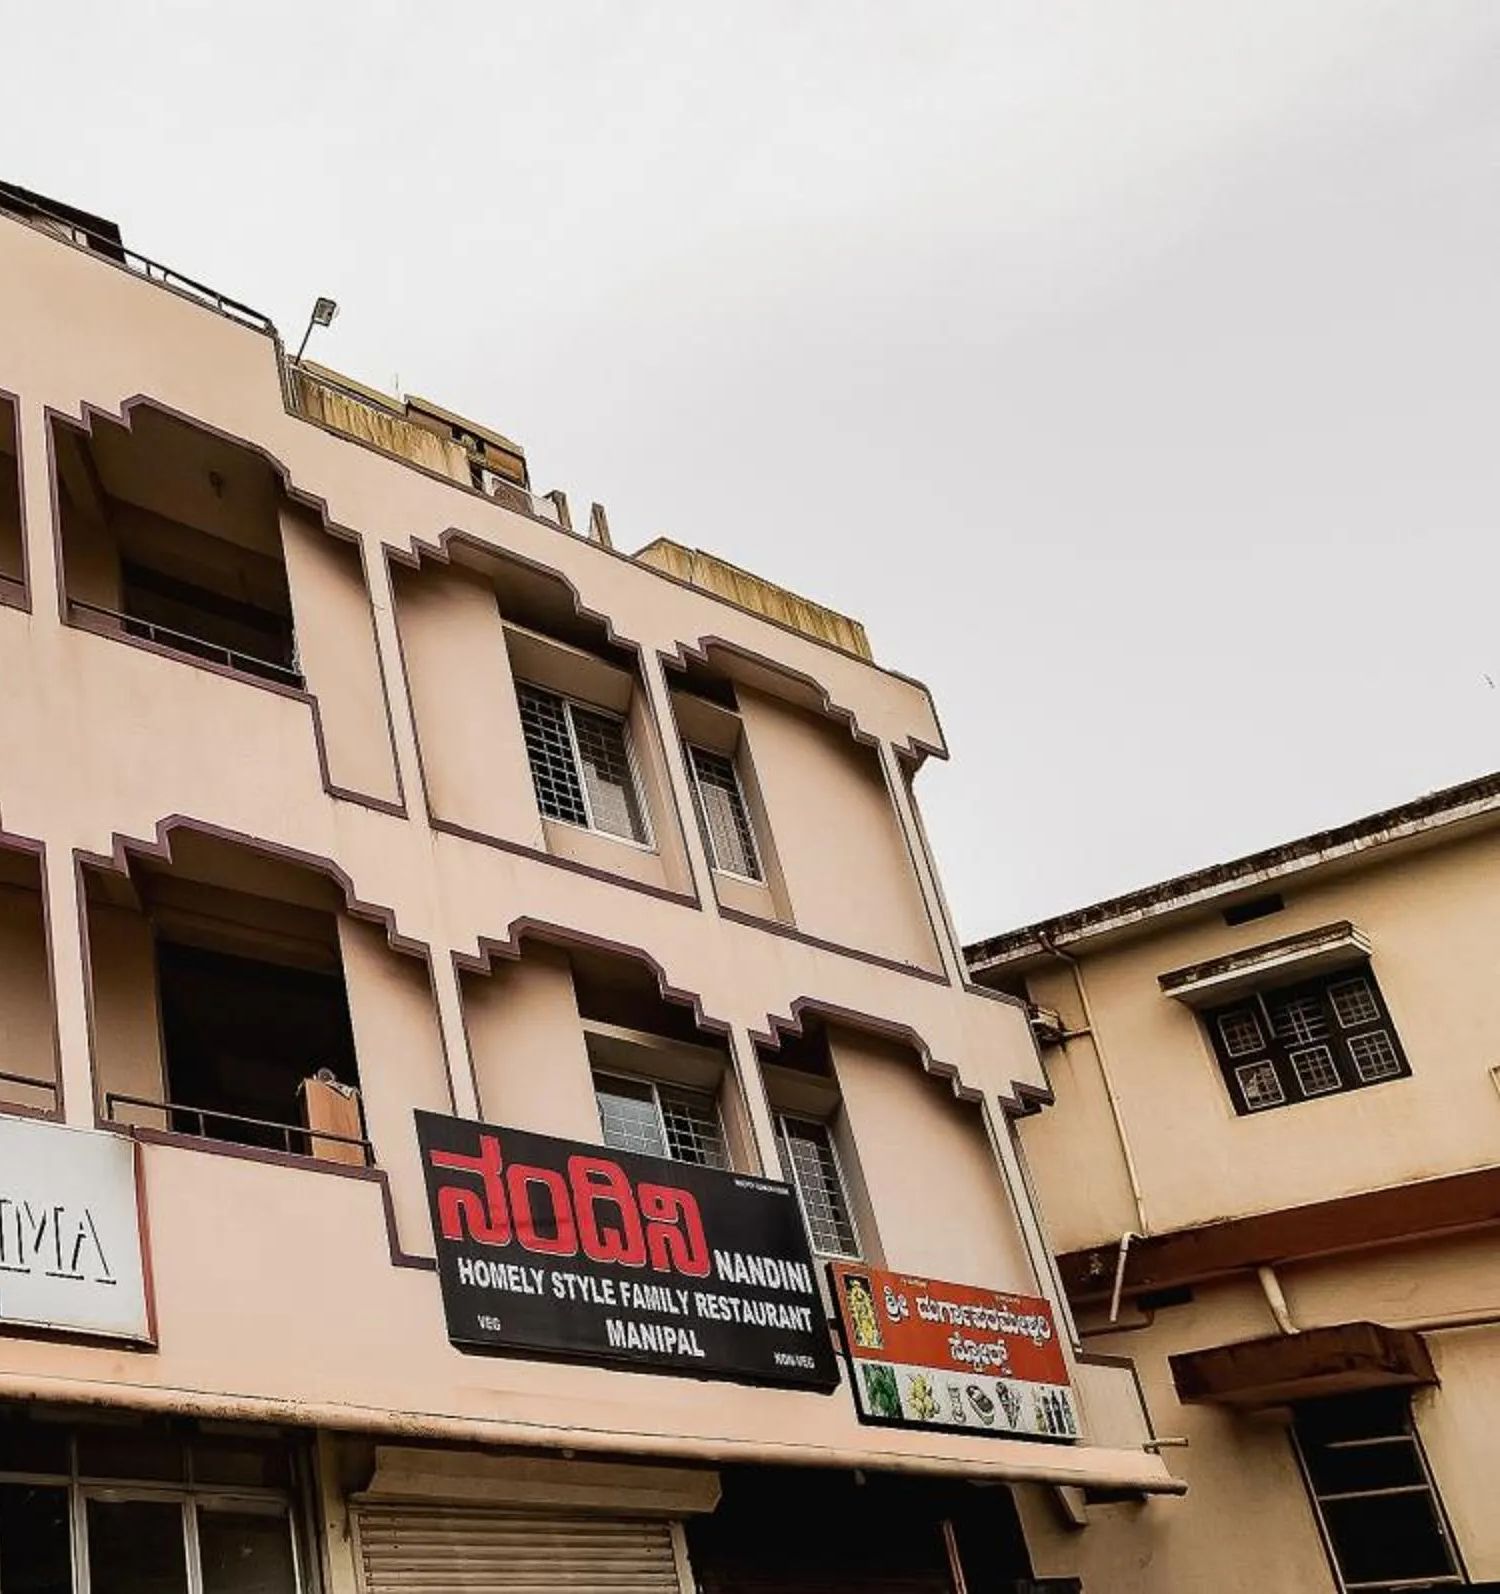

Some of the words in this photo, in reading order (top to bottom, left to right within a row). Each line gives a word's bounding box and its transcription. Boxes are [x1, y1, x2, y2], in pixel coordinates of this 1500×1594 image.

[429, 1134, 711, 1280] ನಂದಿನಿ
[456, 1256, 546, 1297] HOMELY
[551, 1270, 618, 1306] STYLE
[619, 1281, 690, 1317] FAMILY
[694, 1291, 814, 1334] RESTAURANT
[713, 1249, 814, 1295] NANDINI
[477, 1315, 501, 1332] VEG
[605, 1319, 706, 1358] MANIPAL
